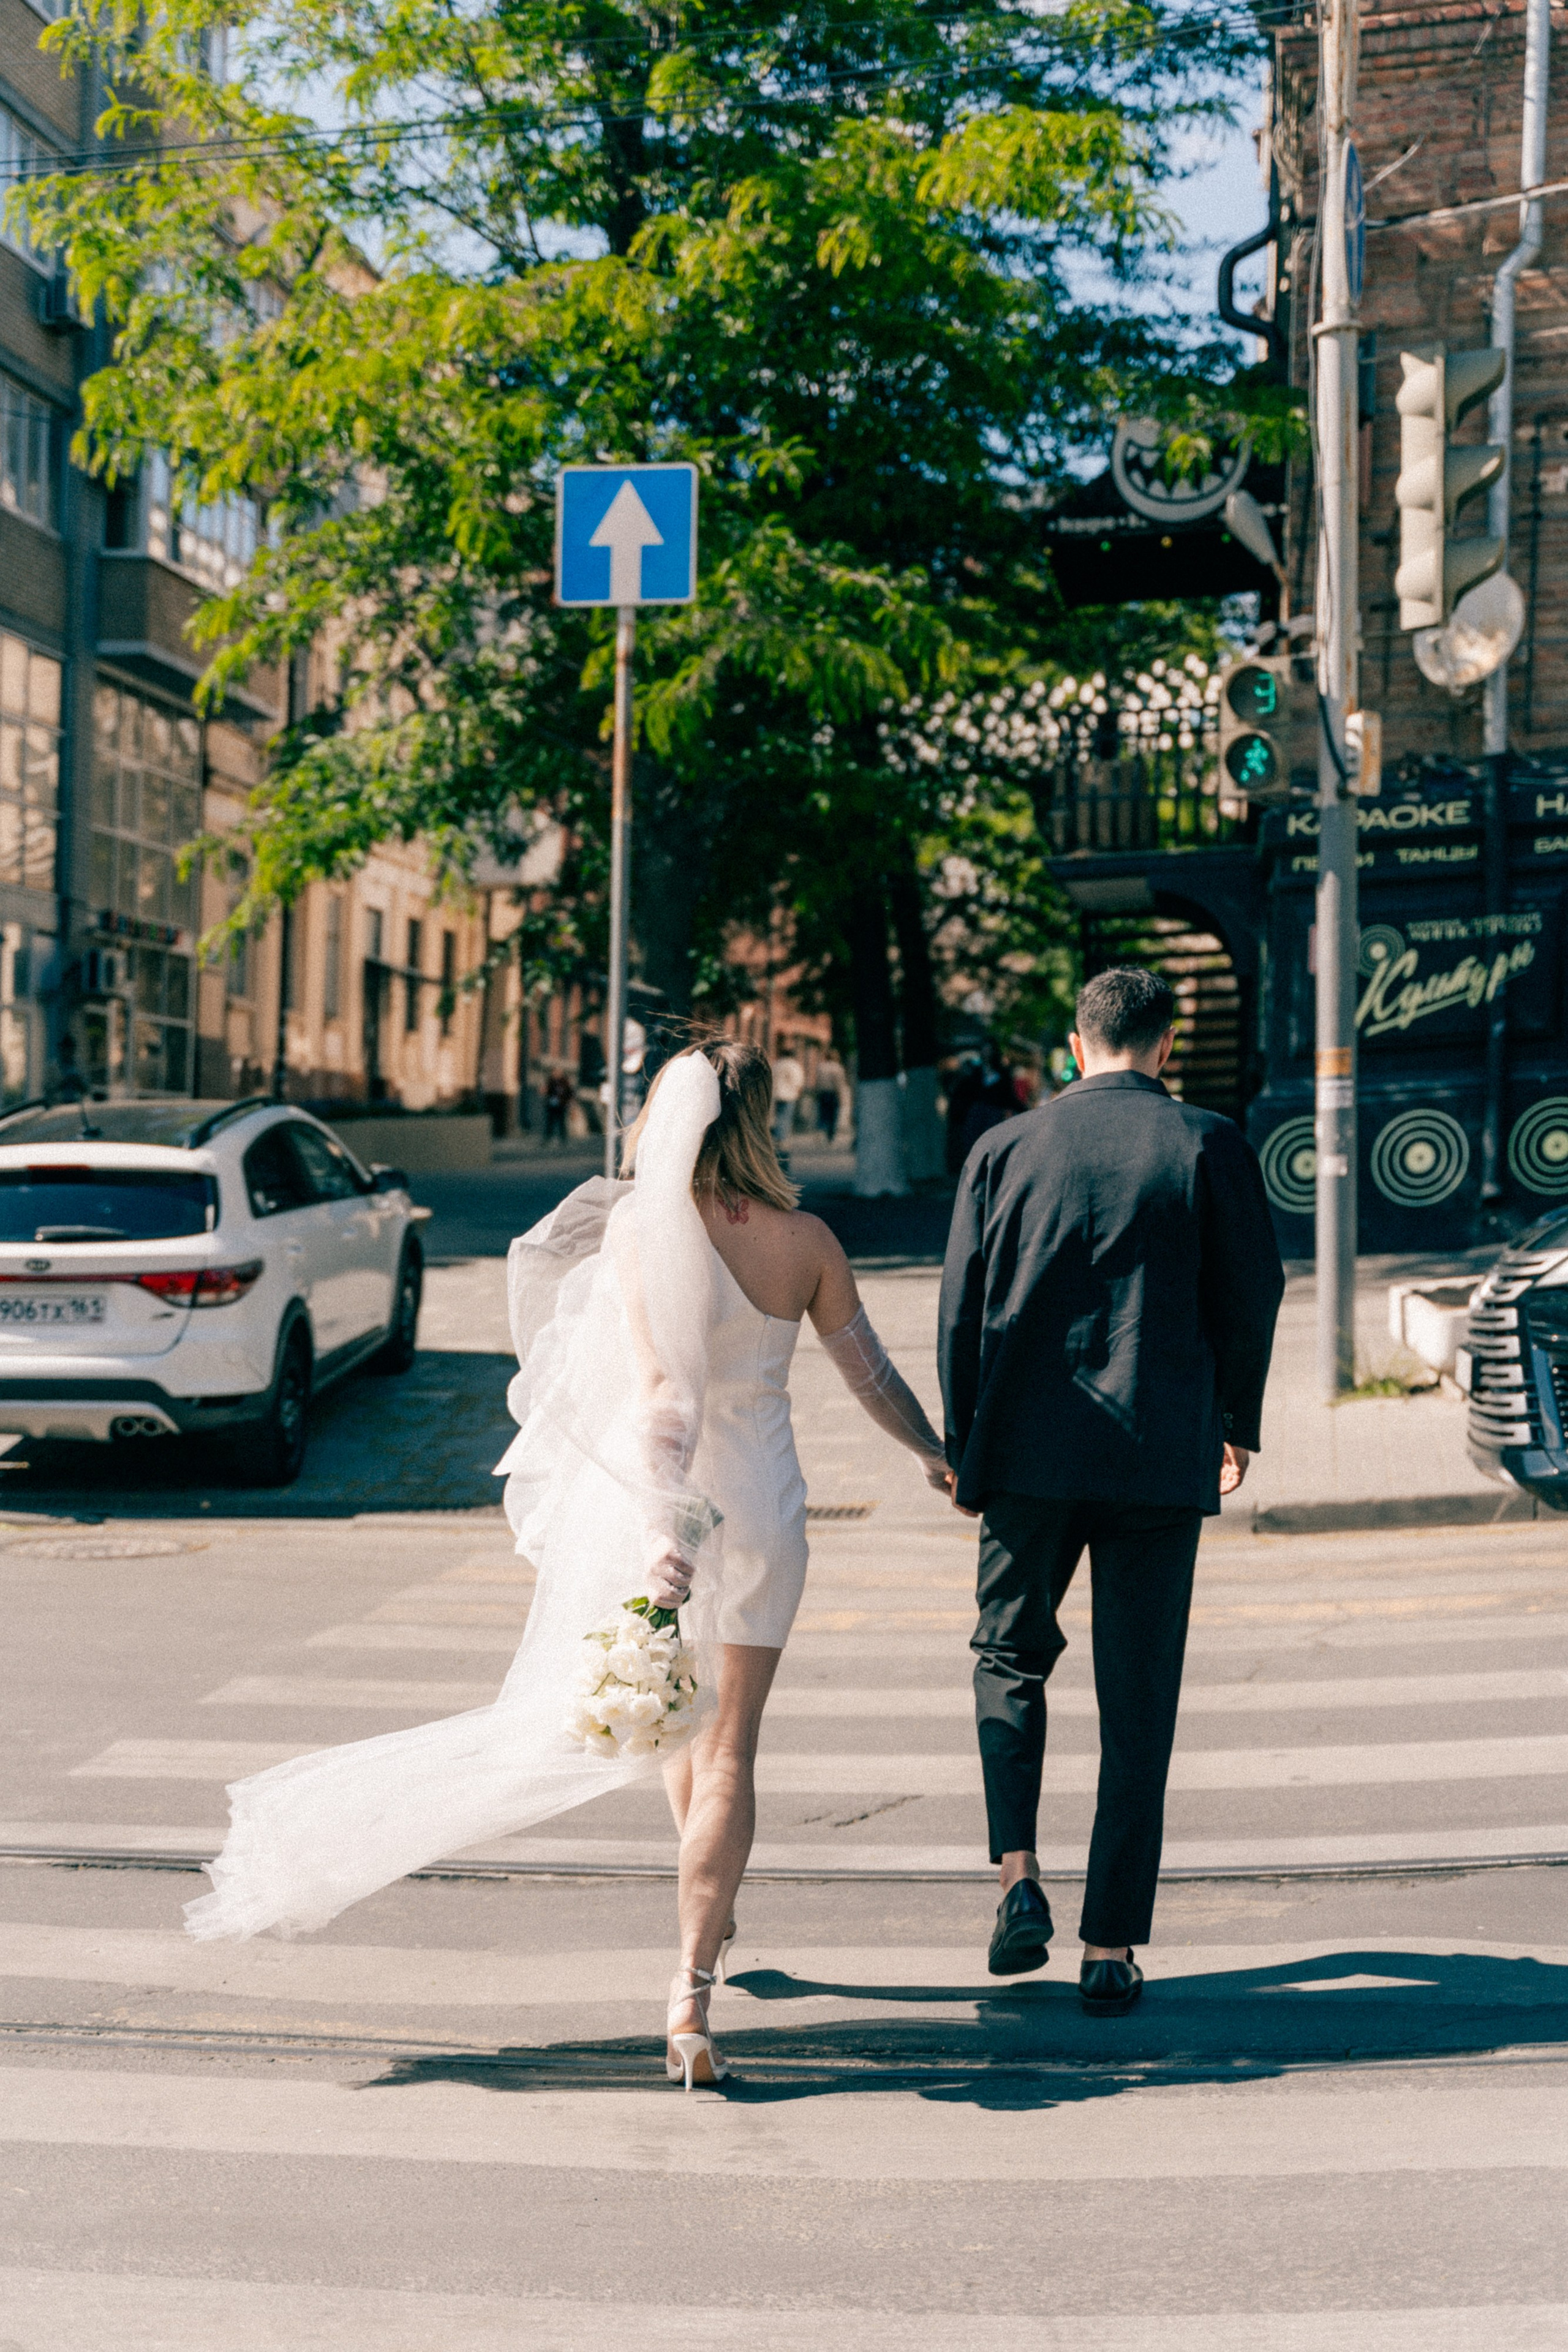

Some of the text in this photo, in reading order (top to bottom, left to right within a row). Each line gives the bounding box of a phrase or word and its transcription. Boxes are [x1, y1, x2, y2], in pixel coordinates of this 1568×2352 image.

[1255, 673, 1276, 714] 3
[1536, 792, 1568, 817] Н
[1287, 800, 1470, 837] КРАОКЕ
[1395, 843, 1478, 864] ТАНЦЫ
[1534, 835, 1568, 854] БА
